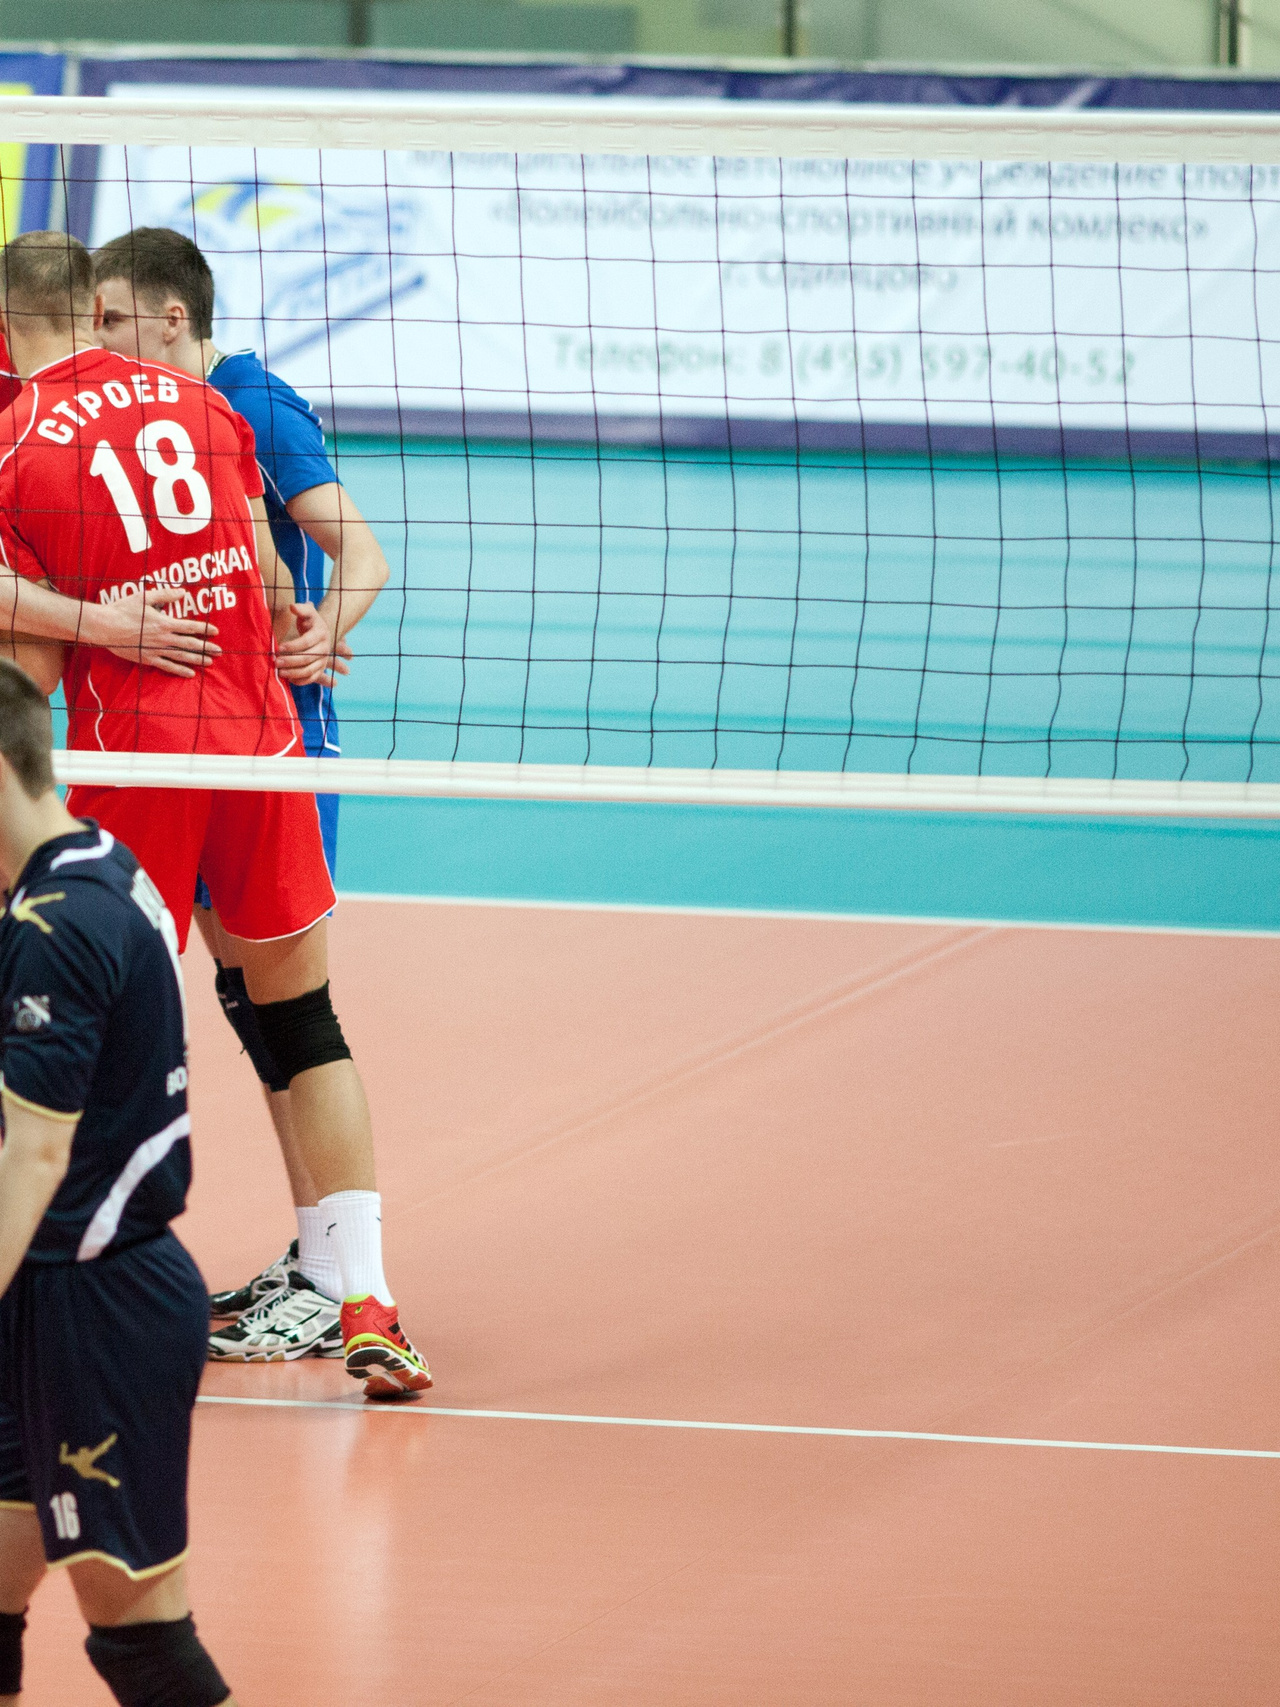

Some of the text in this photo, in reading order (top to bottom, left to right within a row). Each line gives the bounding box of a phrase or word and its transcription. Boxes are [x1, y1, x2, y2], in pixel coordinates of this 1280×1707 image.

[37, 374, 180, 445] СТРОЕВ
[89, 420, 212, 553] 18
[49, 1491, 81, 1540] 16
